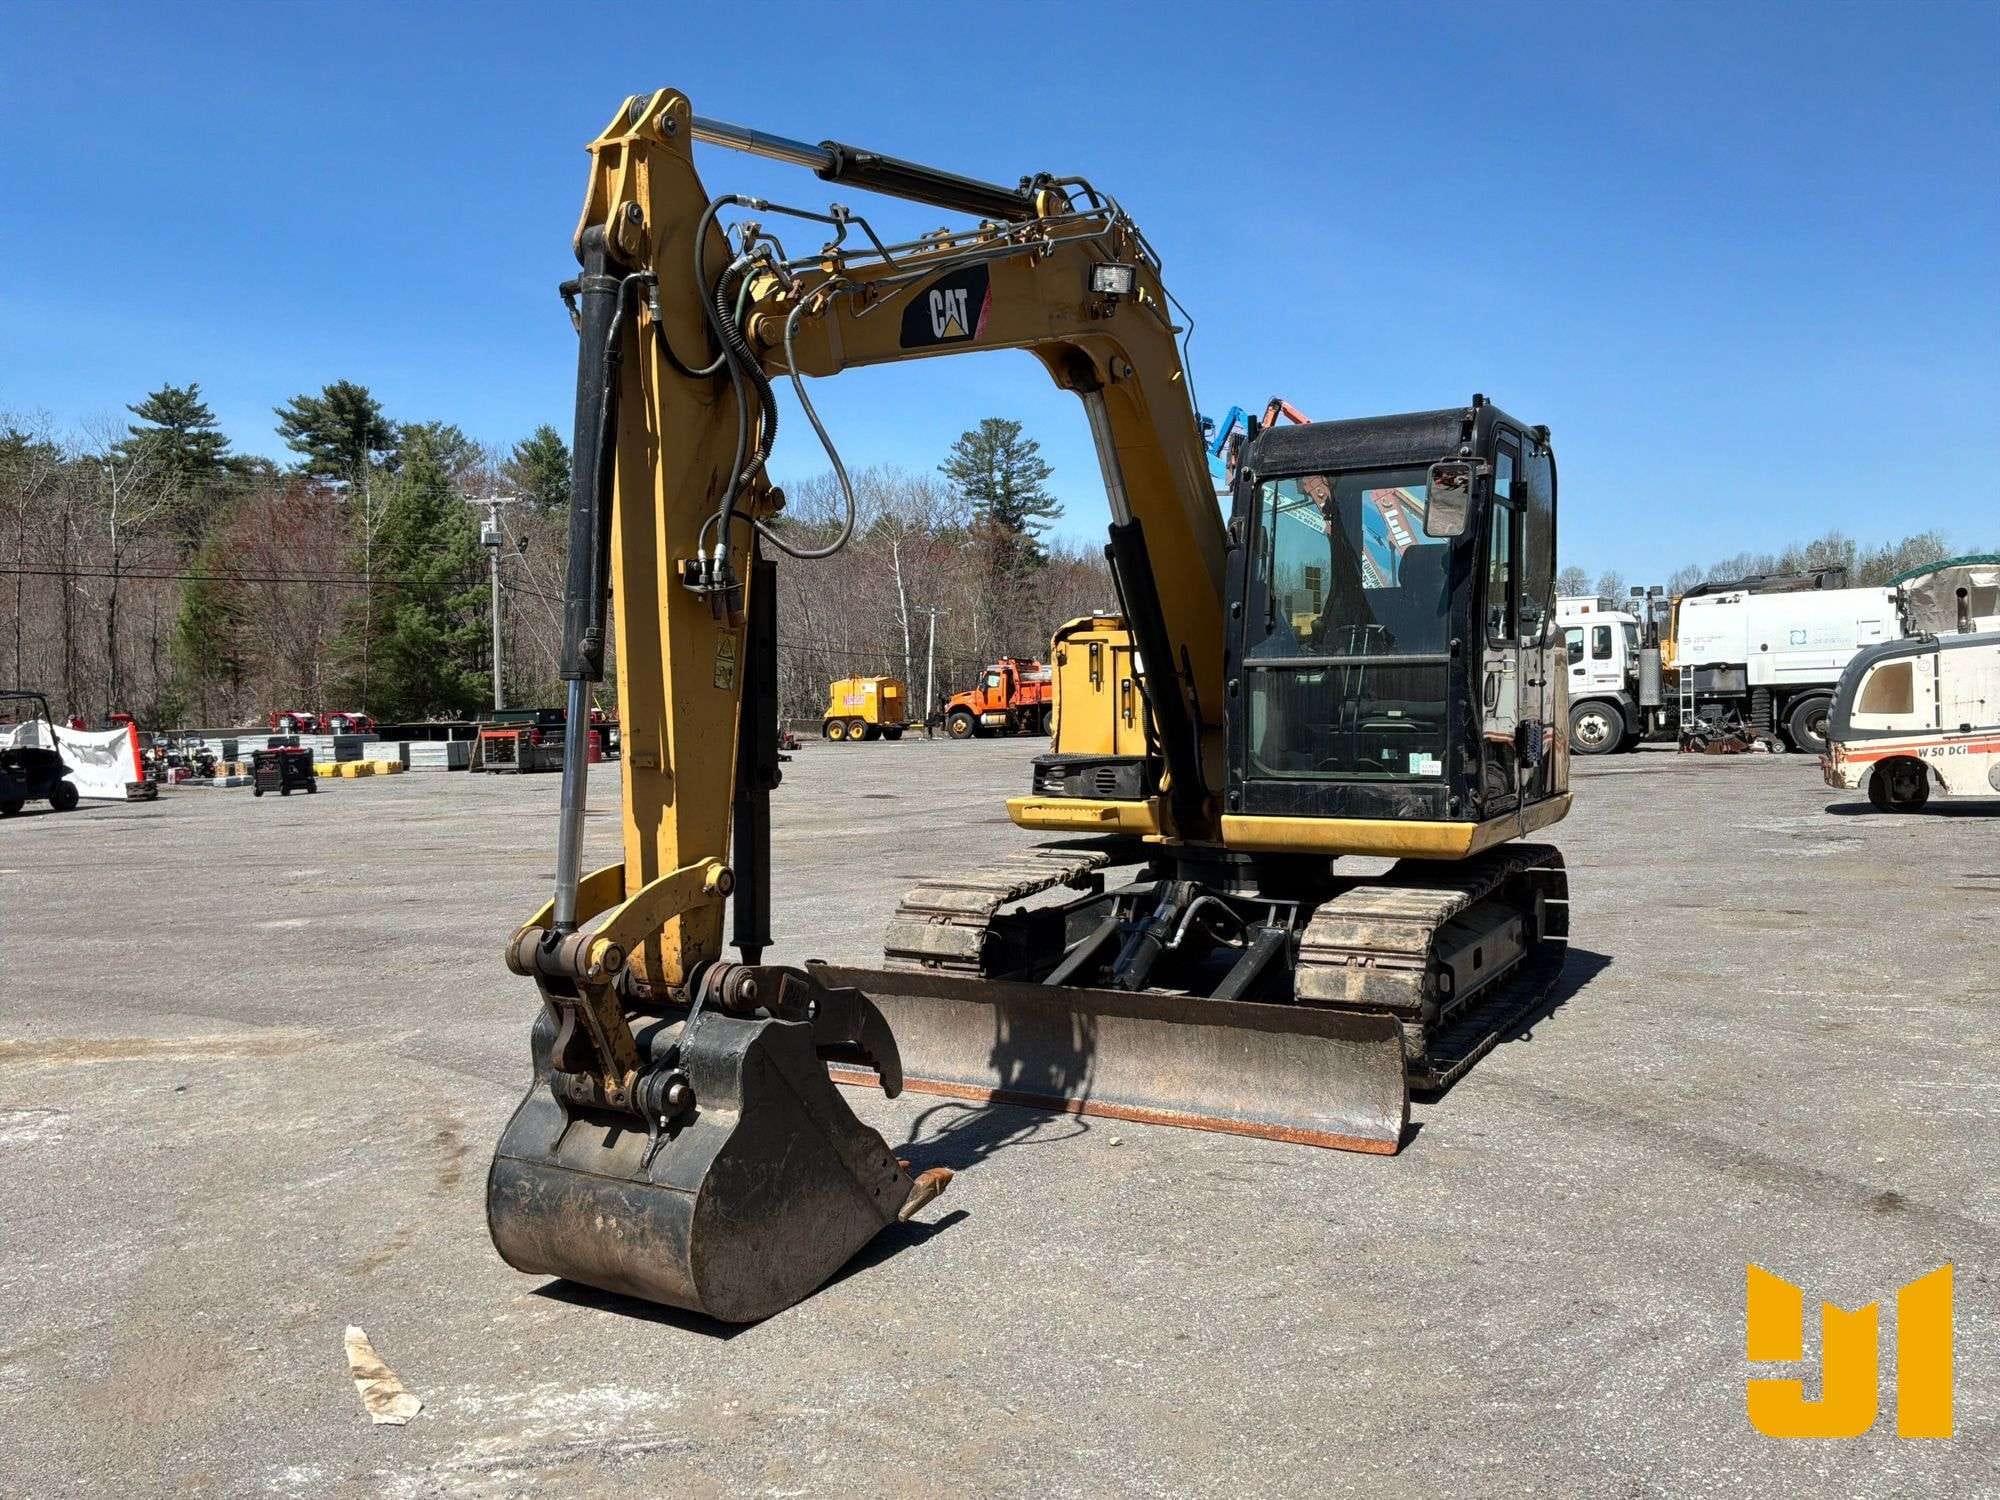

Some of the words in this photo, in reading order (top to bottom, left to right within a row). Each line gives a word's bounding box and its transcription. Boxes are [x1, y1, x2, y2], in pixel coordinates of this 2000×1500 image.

[929, 288, 969, 338] CAT
[1919, 748, 1928, 757] W
[1931, 747, 1945, 757] 50
[1949, 745, 1966, 755] DCi
